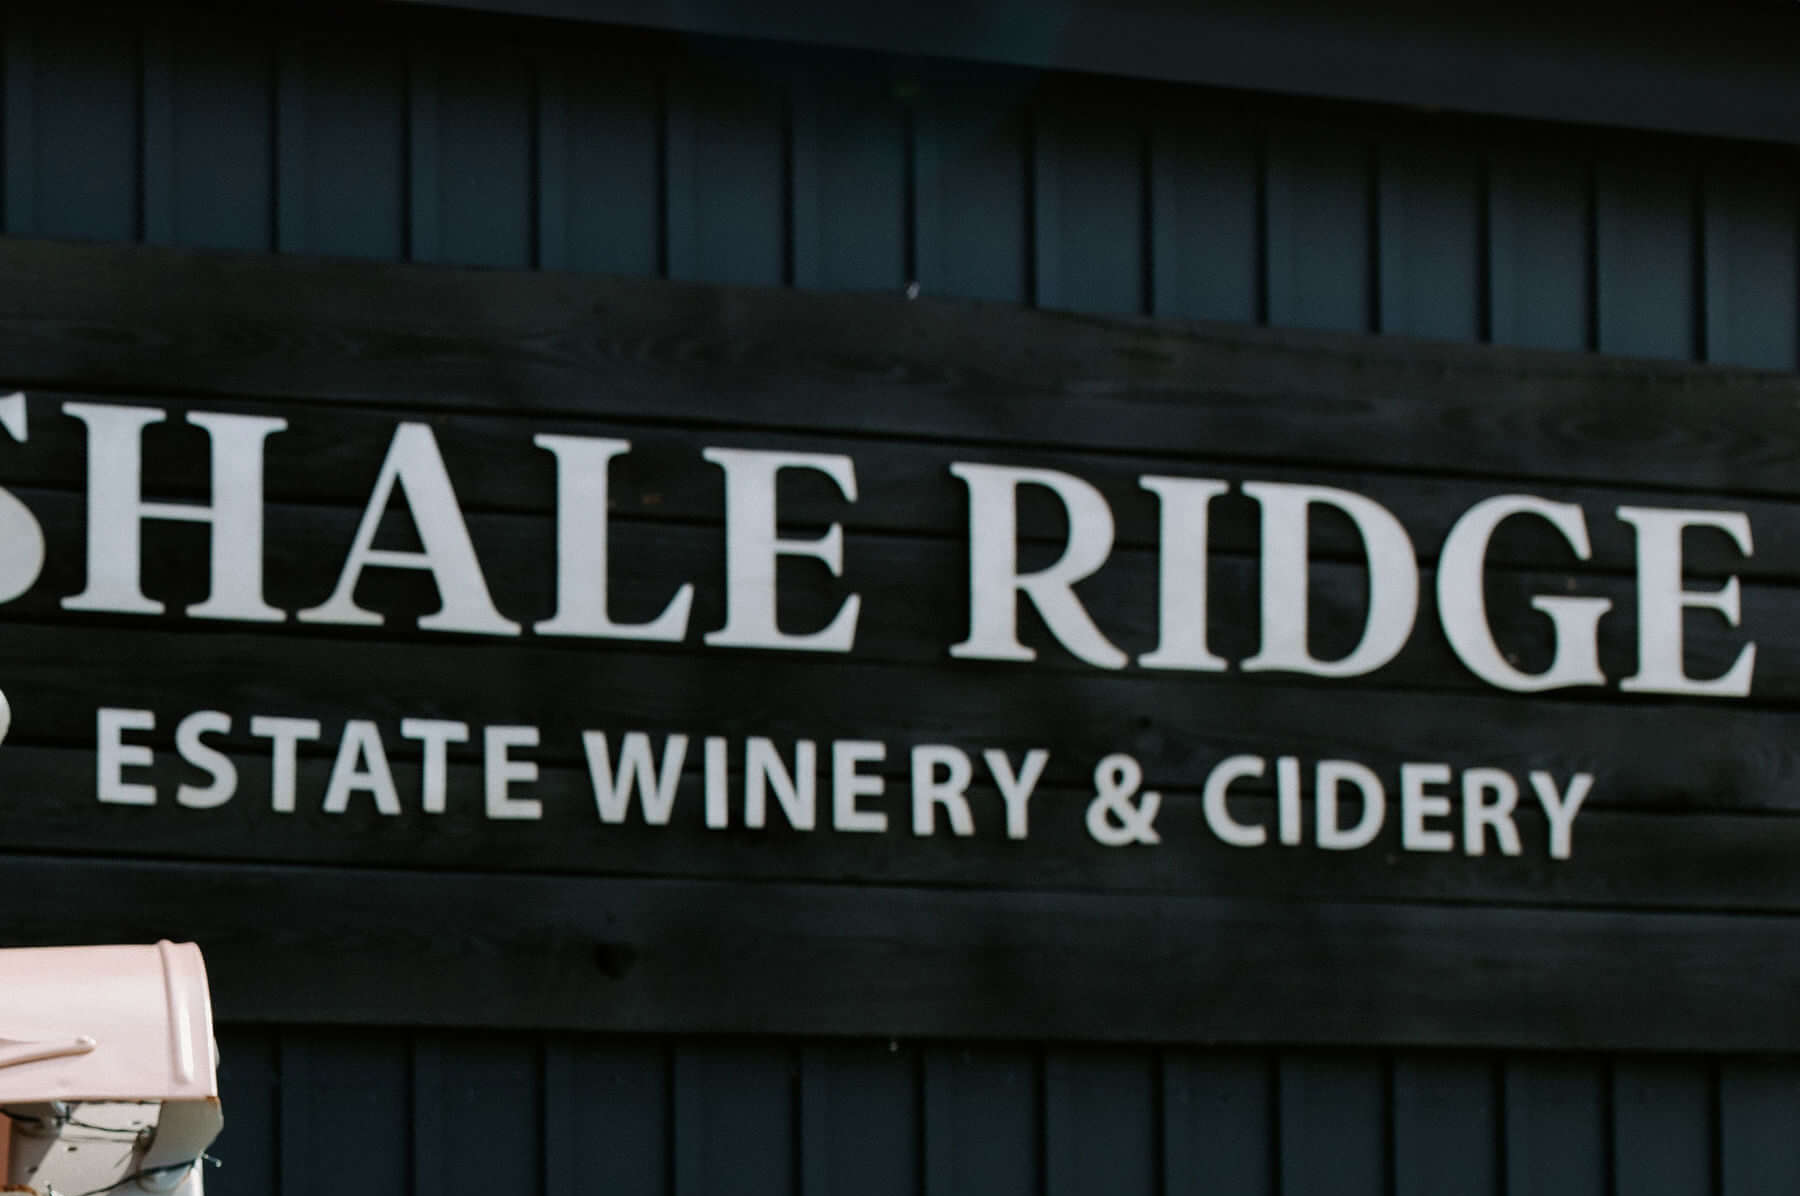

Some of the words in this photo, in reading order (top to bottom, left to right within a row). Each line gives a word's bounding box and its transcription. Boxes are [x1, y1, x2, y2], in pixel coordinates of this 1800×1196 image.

[949, 461, 1757, 698] RIDGE
[96, 707, 543, 820] ESTATE
[582, 730, 1049, 840] WINERY
[1084, 752, 1163, 847] &
[1202, 754, 1595, 860] CIDERY
